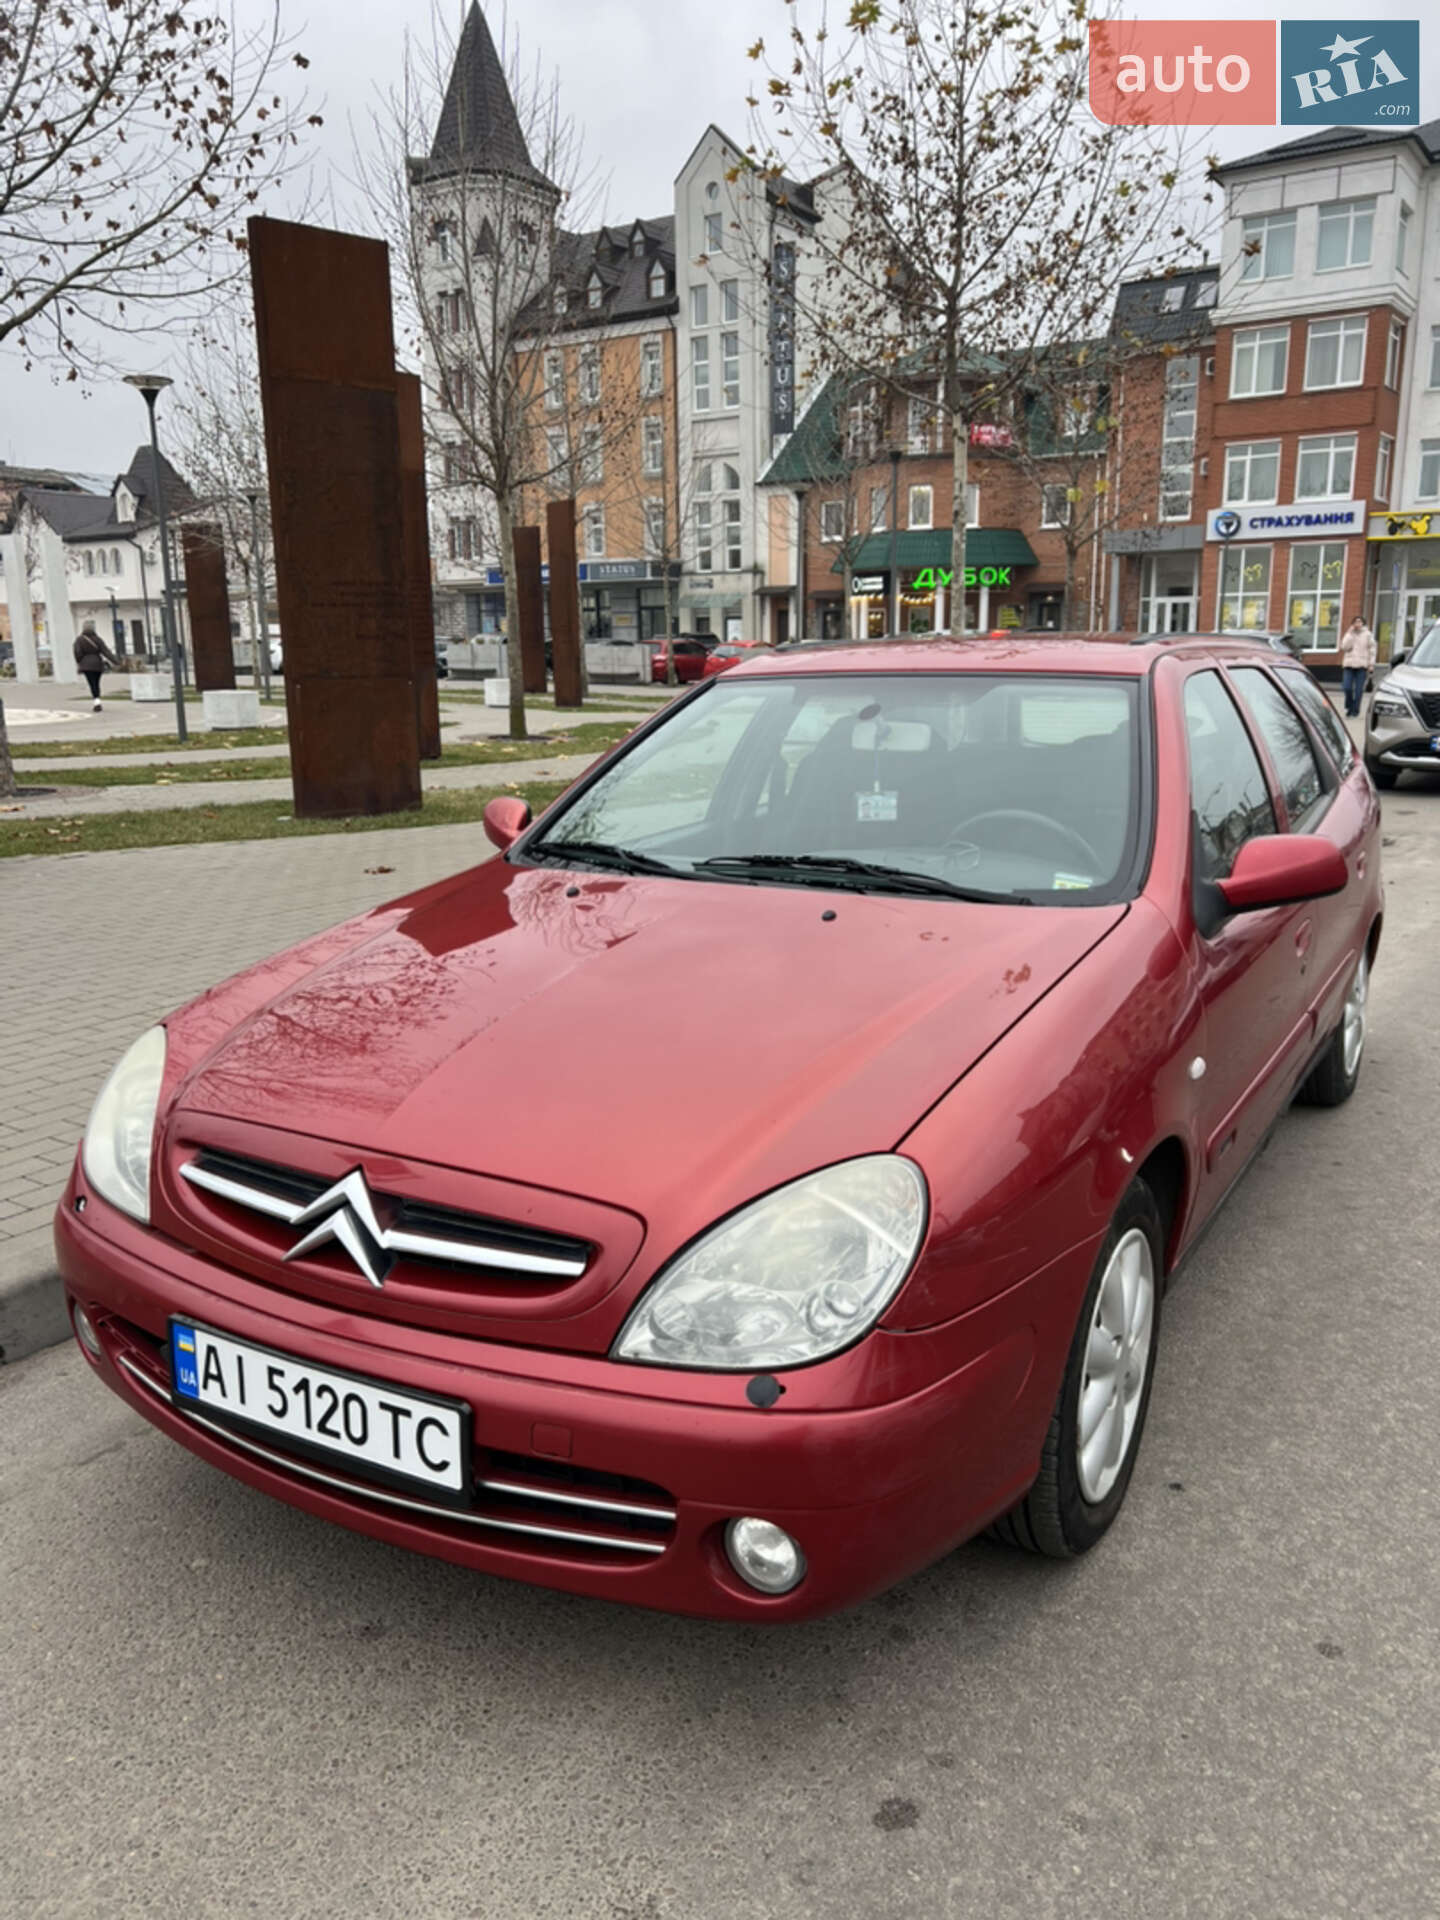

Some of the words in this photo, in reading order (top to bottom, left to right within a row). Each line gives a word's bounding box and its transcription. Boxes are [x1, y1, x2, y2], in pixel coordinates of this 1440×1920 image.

[775, 260, 790, 410] SATUS
[1249, 512, 1355, 529] СТРАХУВАННЯ
[912, 566, 1011, 590] ДУБОК
[180, 1367, 197, 1387] UA
[202, 1344, 246, 1406] AI
[267, 1365, 369, 1447] 5120
[379, 1401, 451, 1473] TC
